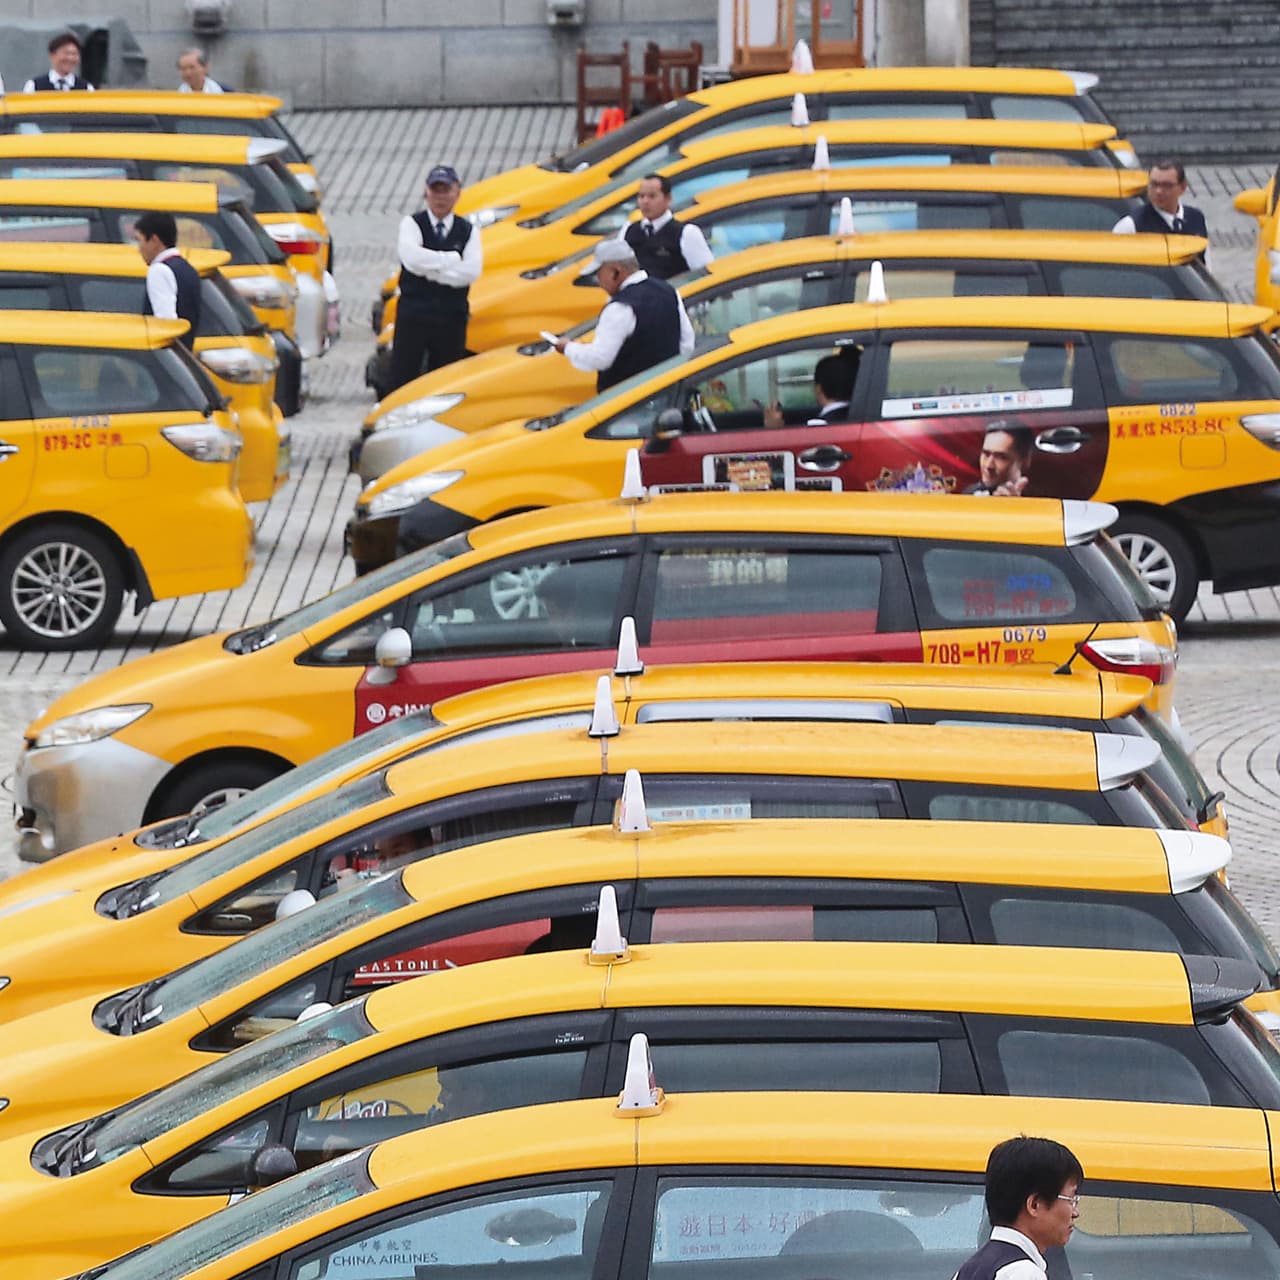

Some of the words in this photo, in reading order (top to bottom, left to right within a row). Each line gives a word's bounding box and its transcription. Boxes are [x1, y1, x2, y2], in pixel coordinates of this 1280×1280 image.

[1002, 627, 1047, 644] 0679
[927, 641, 1001, 664] 708-H7
[332, 1253, 378, 1268] CHINA
[379, 1252, 439, 1266] AIRLINES
